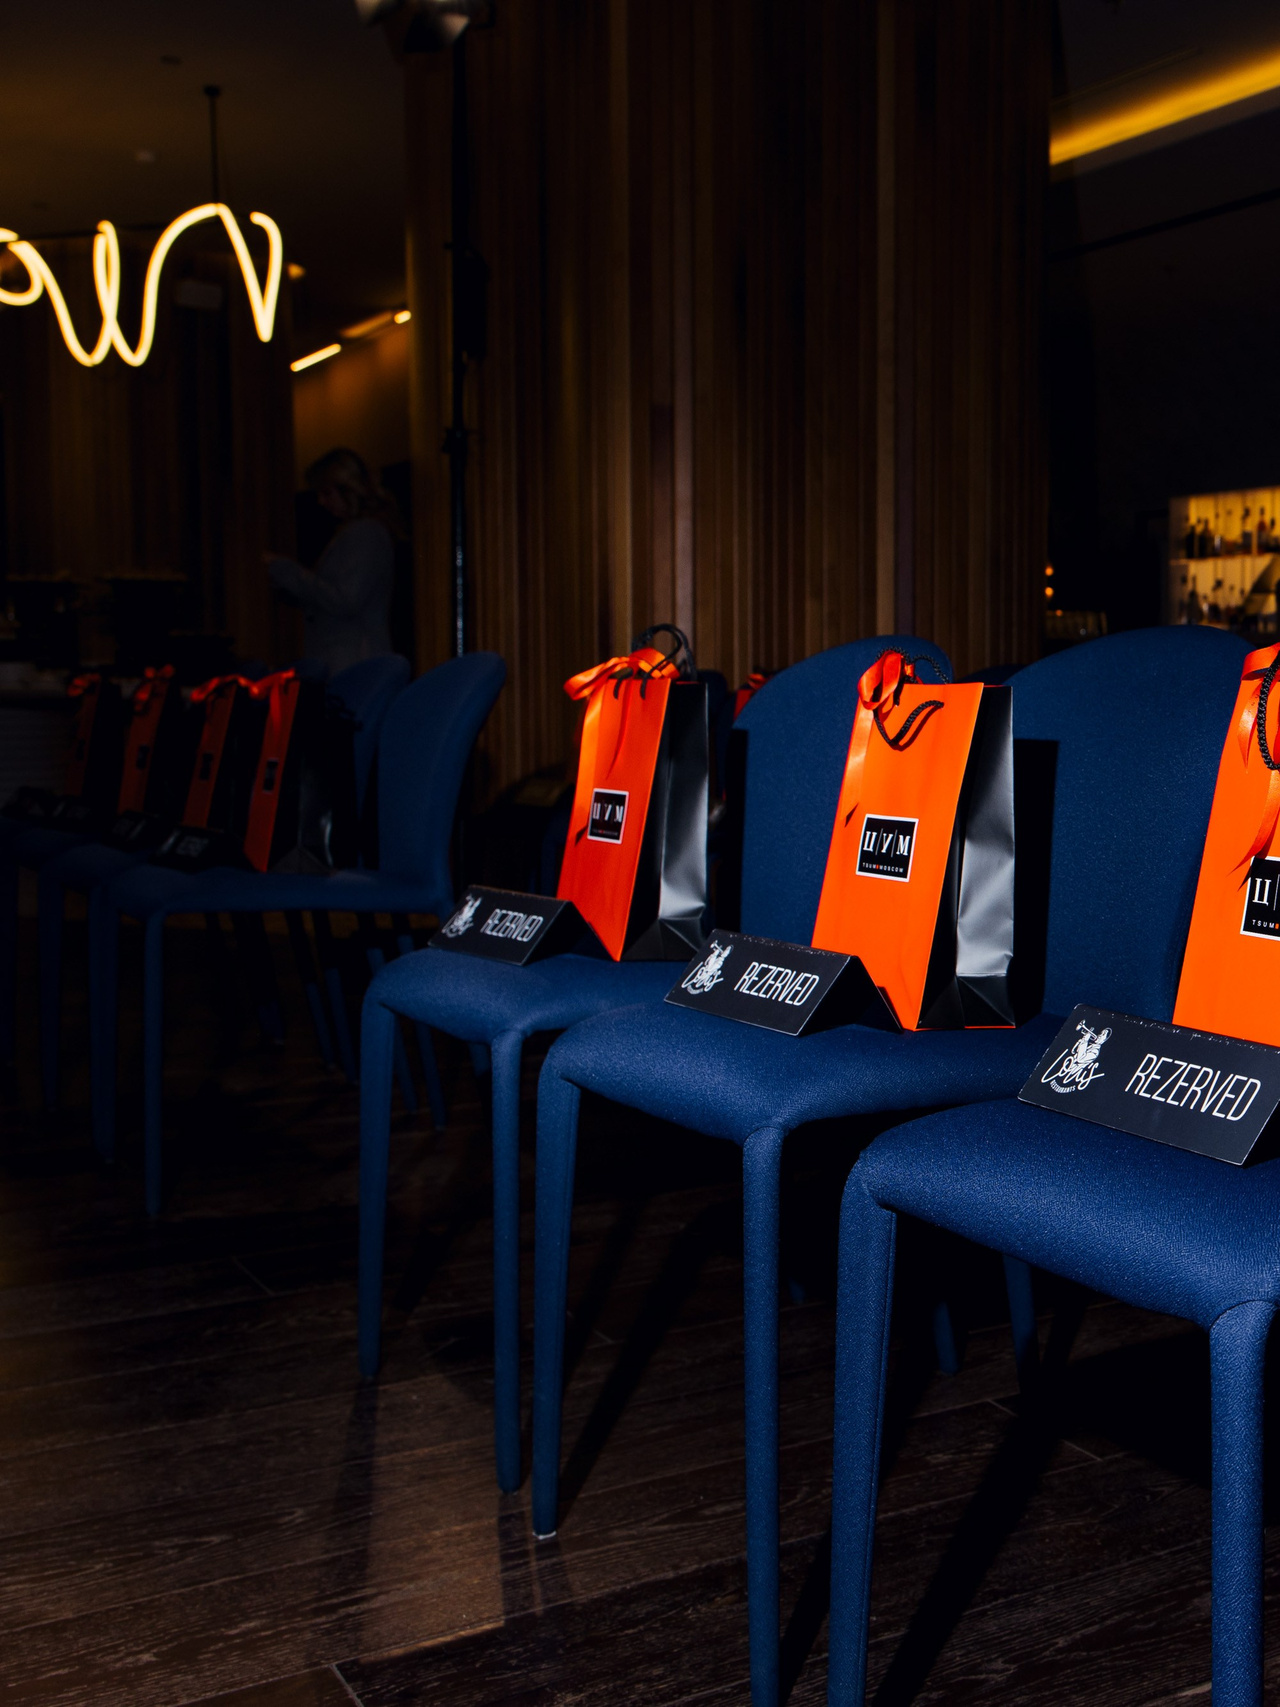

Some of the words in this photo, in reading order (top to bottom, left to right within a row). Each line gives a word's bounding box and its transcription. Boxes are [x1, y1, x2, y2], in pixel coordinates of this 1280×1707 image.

[480, 908, 544, 943] REZERVED
[1252, 919, 1275, 929] TSUM
[733, 961, 820, 1006] REZERVED
[1124, 1053, 1262, 1121] REZERVED
